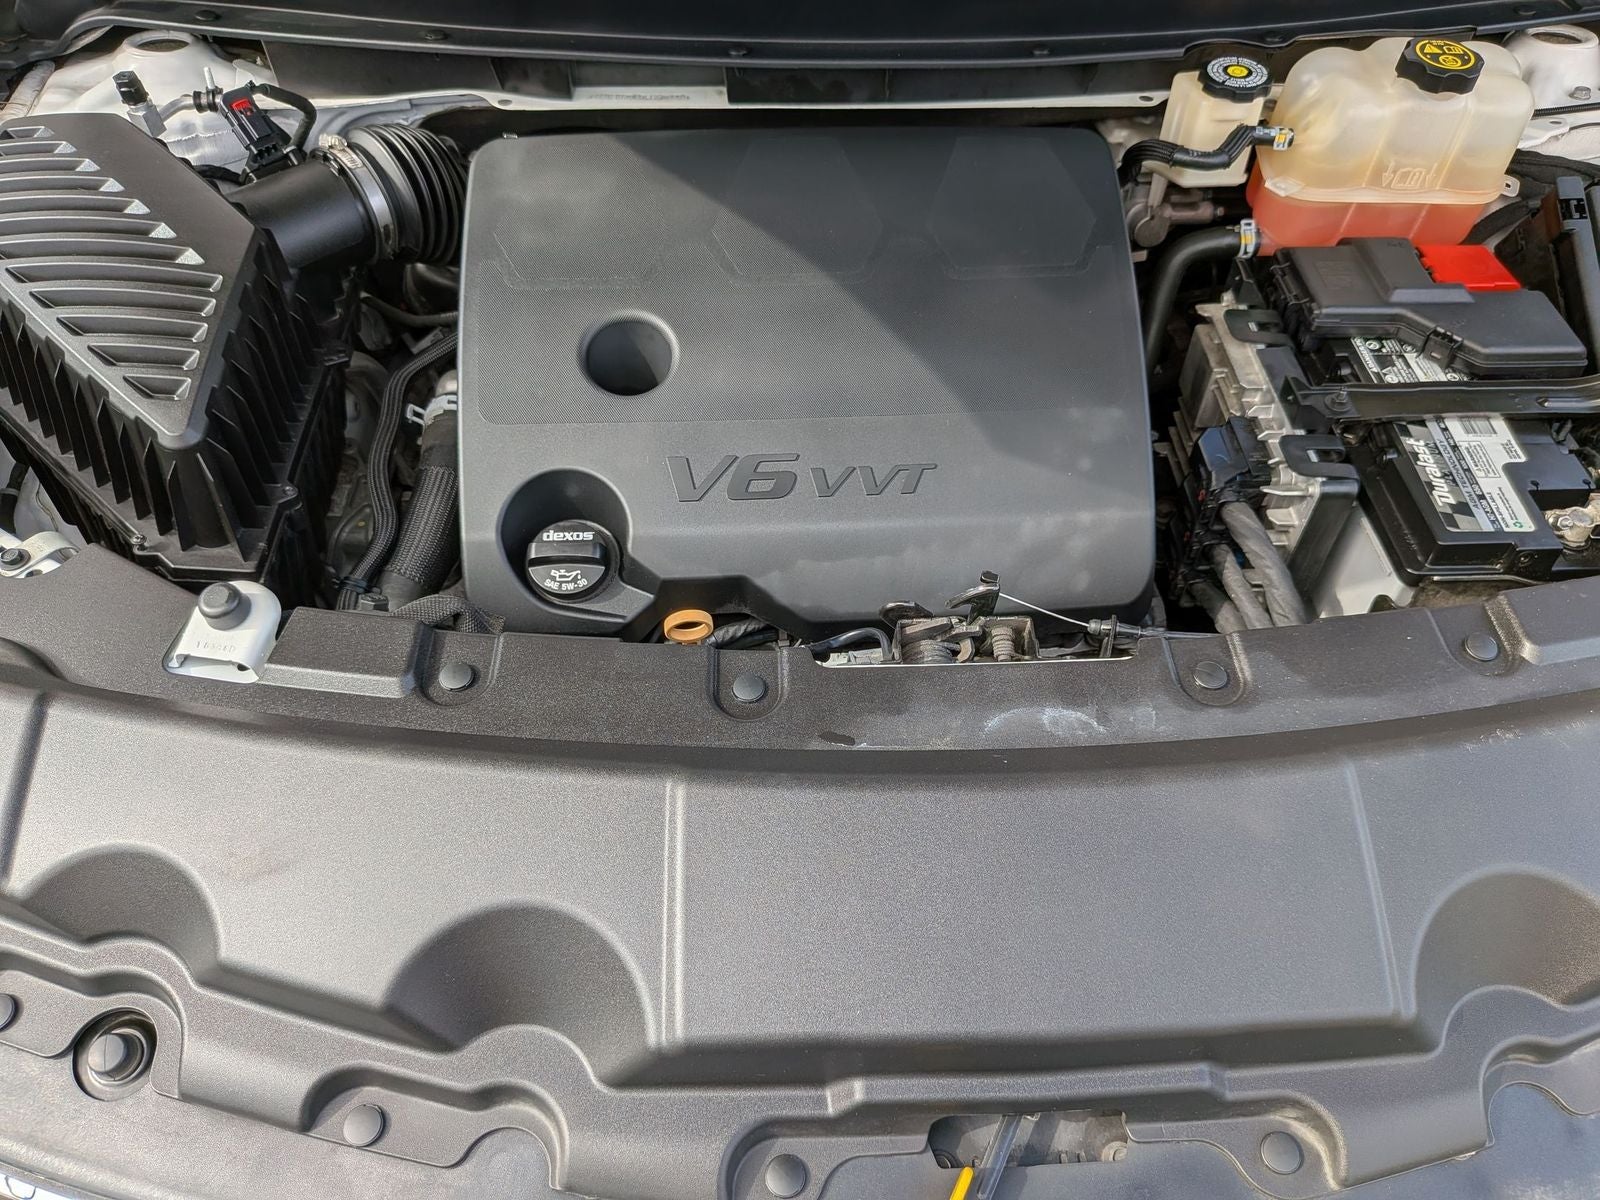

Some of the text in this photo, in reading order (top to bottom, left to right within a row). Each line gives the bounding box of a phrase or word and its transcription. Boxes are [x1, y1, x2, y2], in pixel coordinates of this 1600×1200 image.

[665, 453, 937, 502] V6 VVT
[1406, 439, 1456, 506] Duralast
[542, 530, 594, 541] dexos
[544, 578, 588, 590] SAE 5W-30
